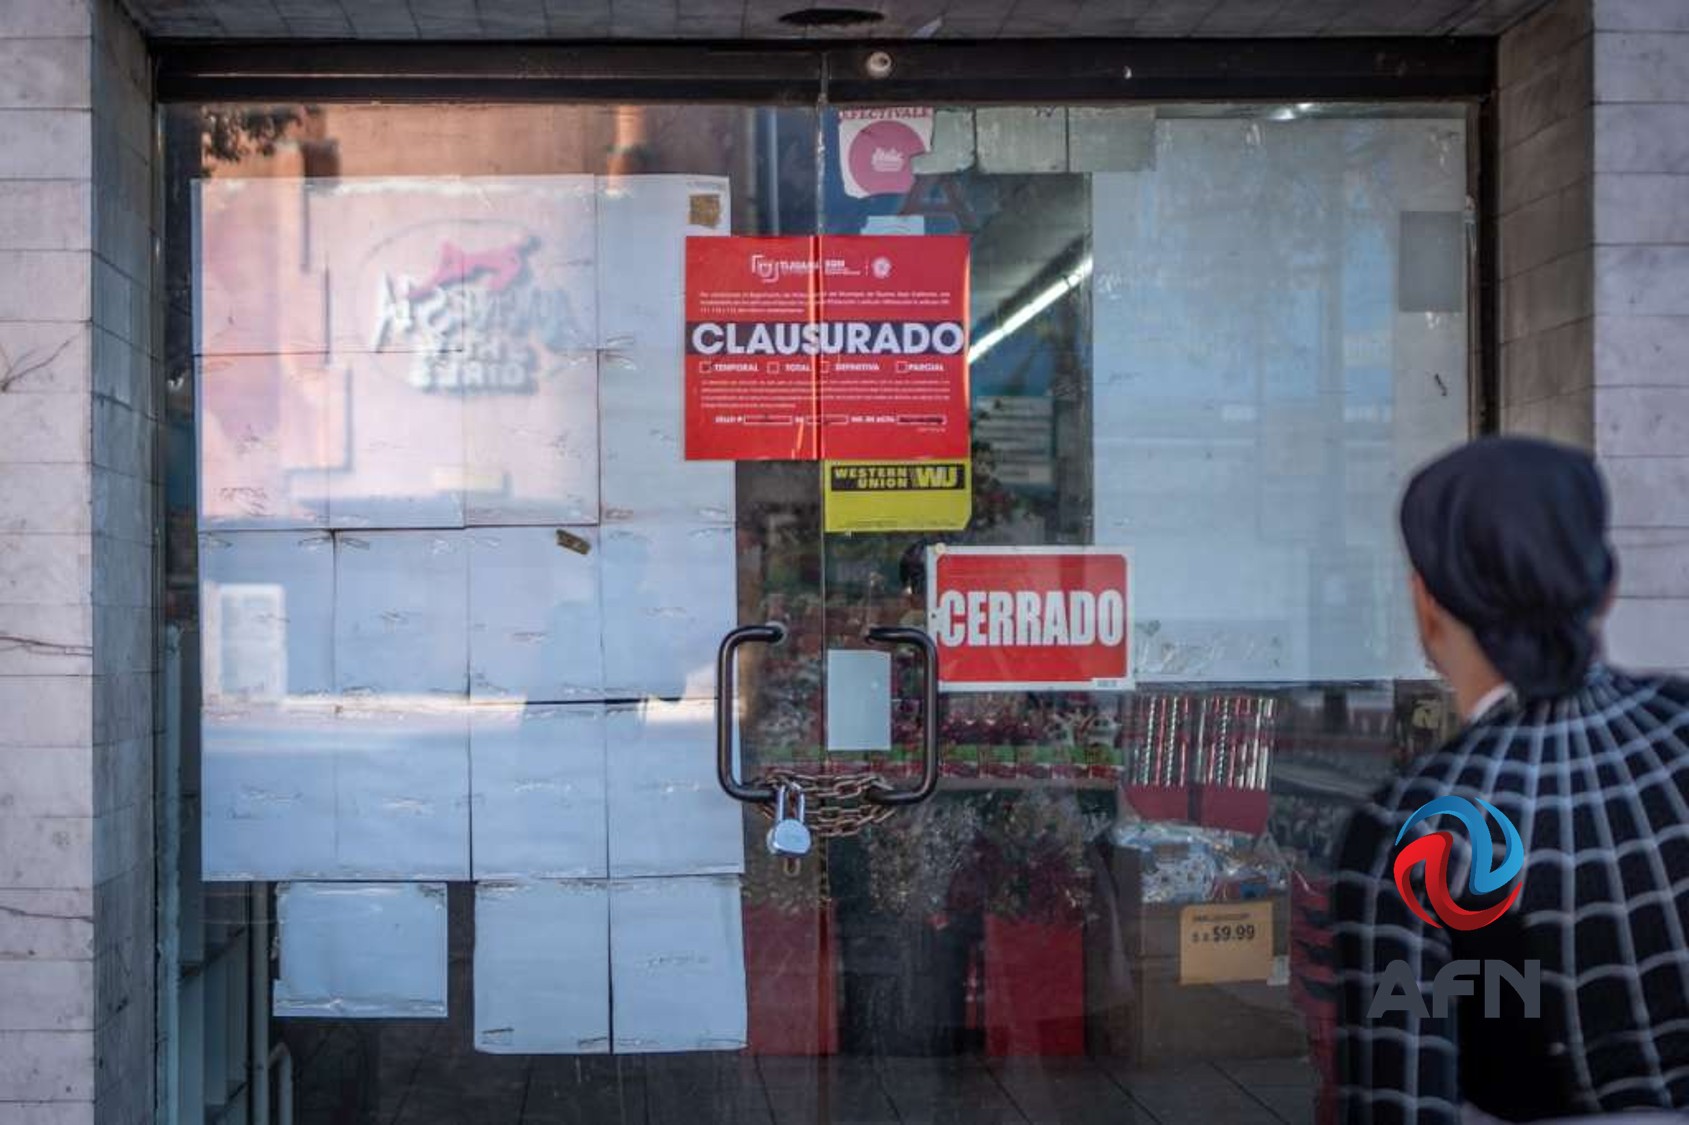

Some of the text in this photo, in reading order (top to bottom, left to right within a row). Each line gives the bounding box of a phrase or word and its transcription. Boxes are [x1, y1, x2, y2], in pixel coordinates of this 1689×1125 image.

[691, 322, 965, 355] CLAUSURADO
[834, 467, 907, 478] WESTERN
[857, 478, 908, 489] UNION
[938, 589, 1124, 648] CERRADO
